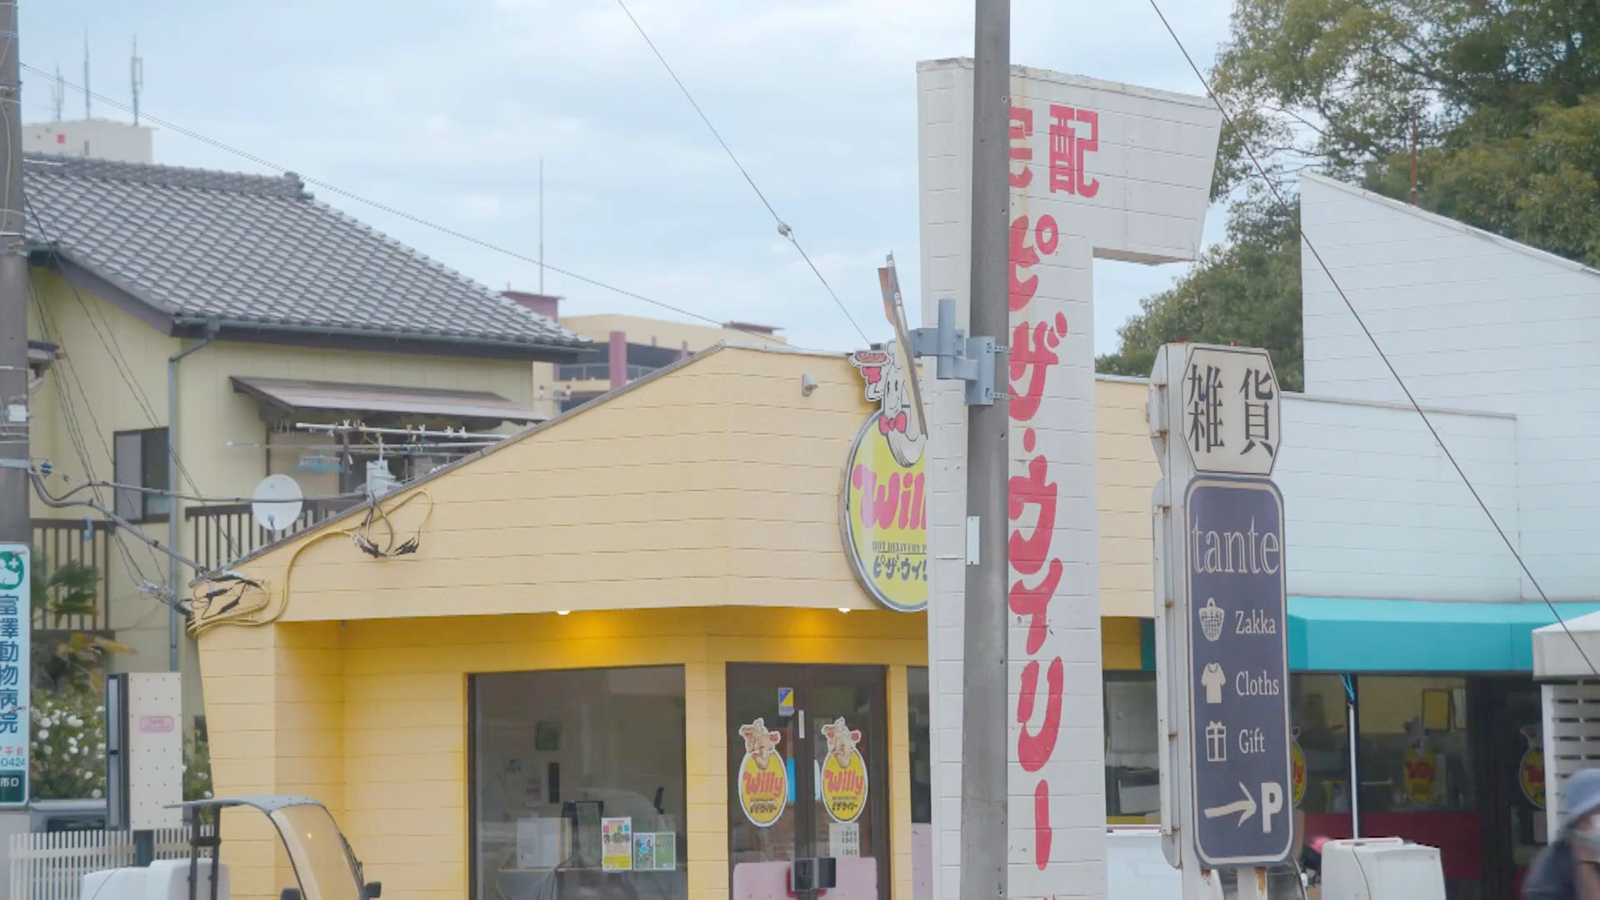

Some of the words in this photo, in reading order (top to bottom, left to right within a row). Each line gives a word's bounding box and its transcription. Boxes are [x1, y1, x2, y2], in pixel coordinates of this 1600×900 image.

[1187, 364, 1274, 457] 雑貨
[853, 464, 926, 530] Wil
[1191, 514, 1279, 574] tante
[1235, 610, 1276, 635] Zakka
[1235, 671, 1279, 696] Cloths
[1238, 728, 1265, 754] Gift
[743, 772, 783, 798] Willy
[826, 769, 864, 795] Willy
[1261, 782, 1283, 834] P
